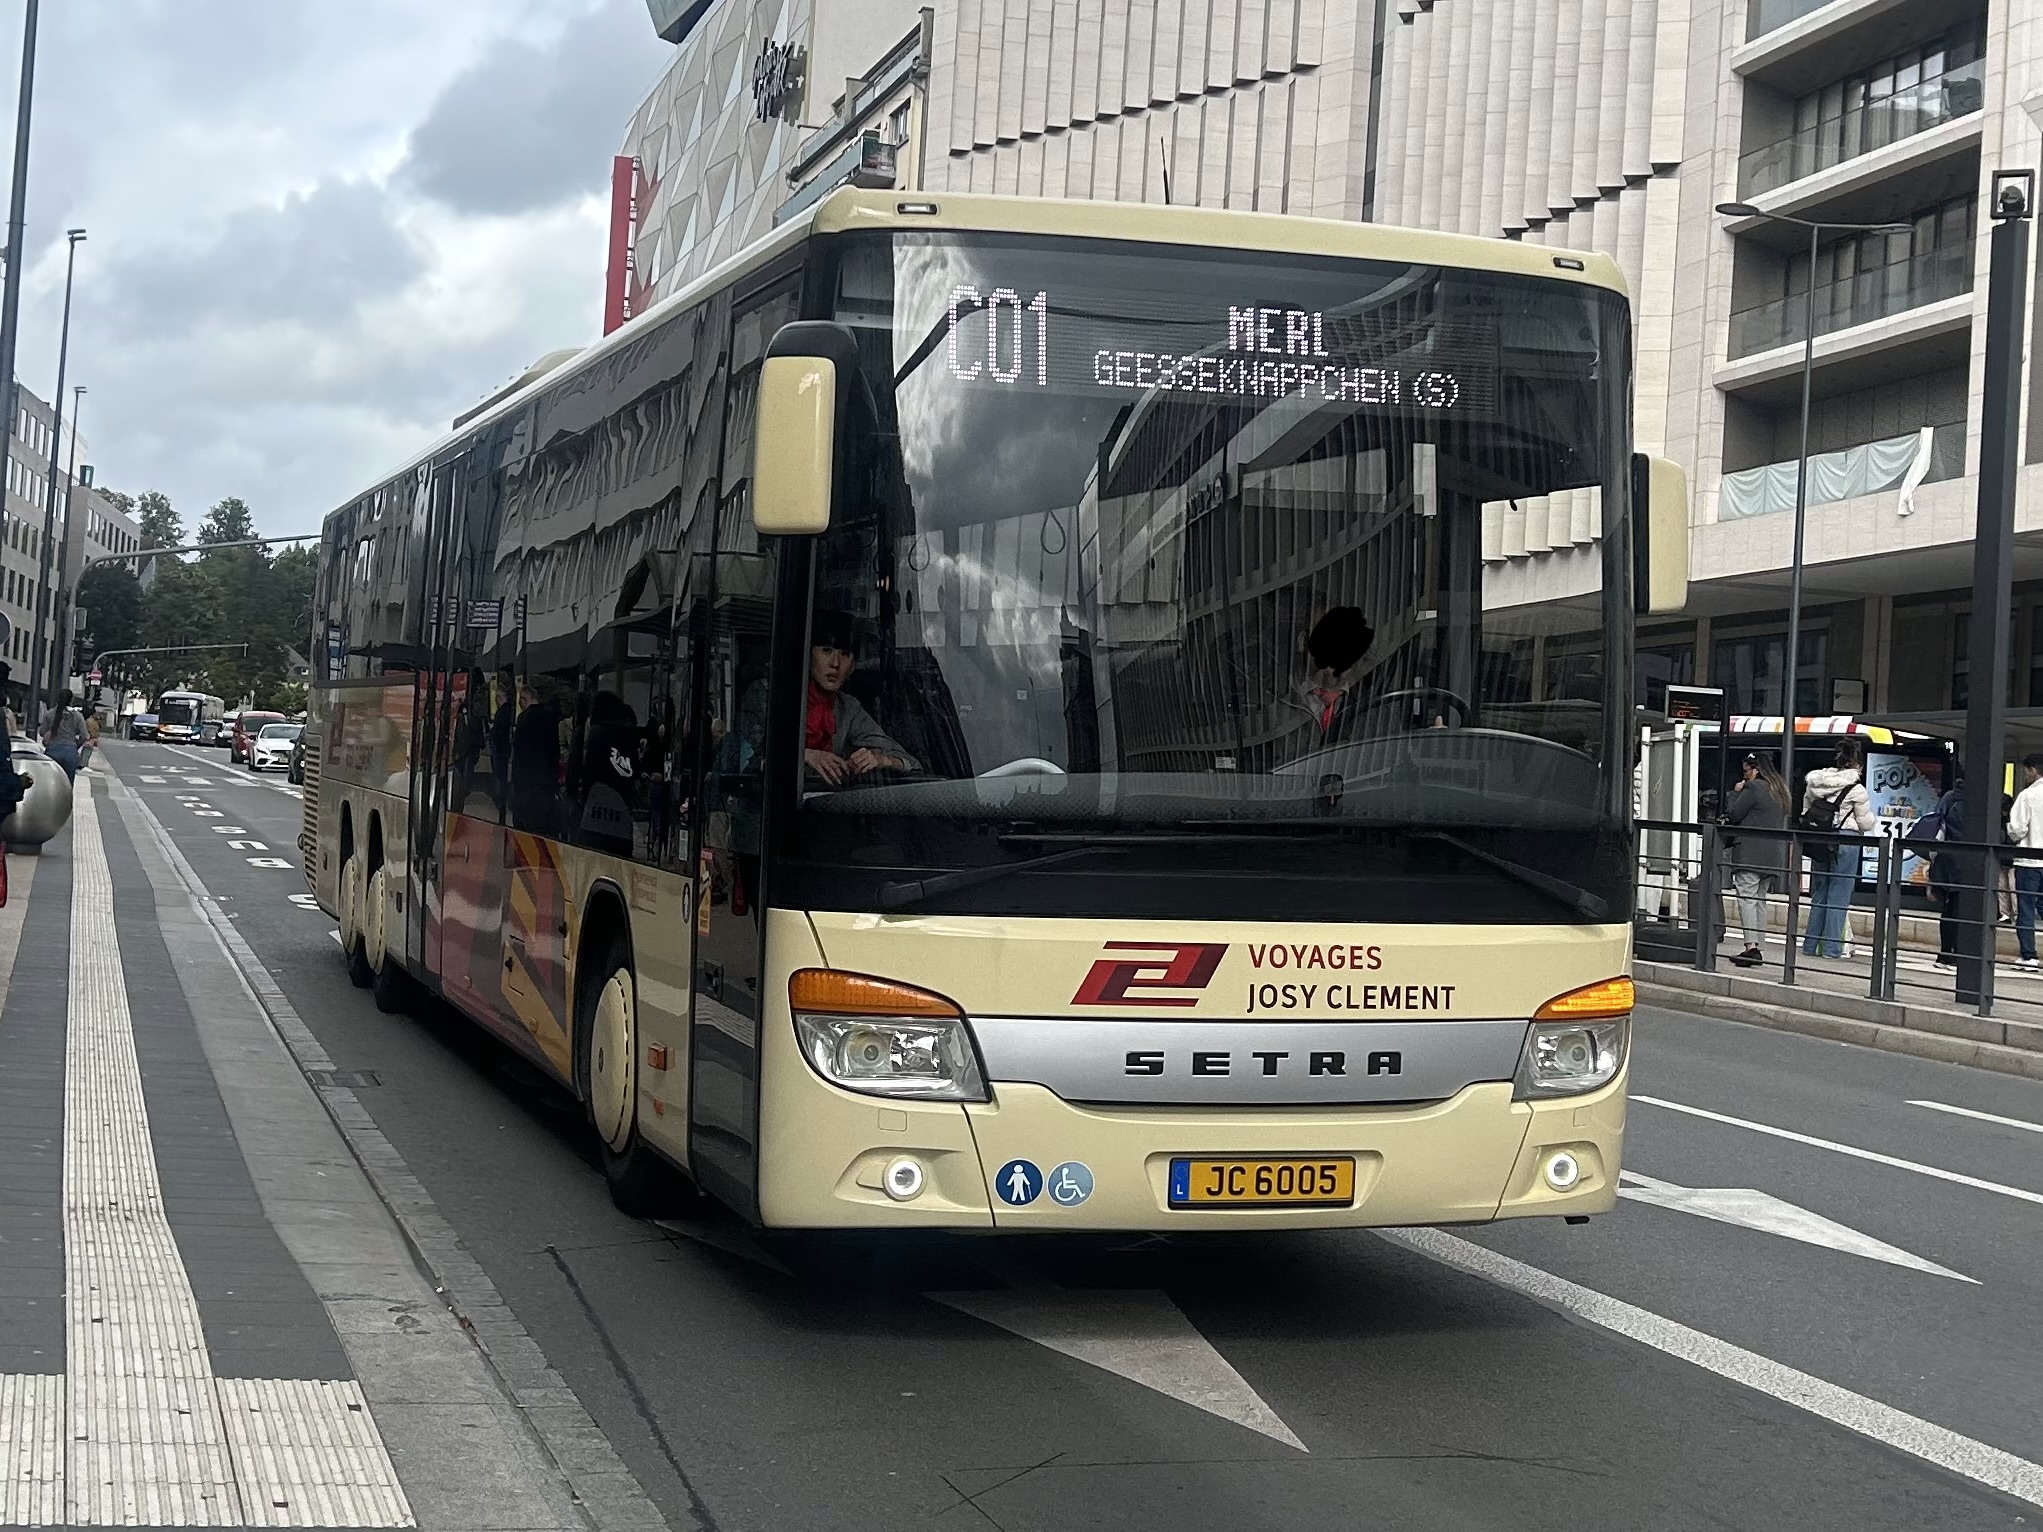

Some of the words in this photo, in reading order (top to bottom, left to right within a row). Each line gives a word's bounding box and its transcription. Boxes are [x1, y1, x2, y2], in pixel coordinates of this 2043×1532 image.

[948, 285, 1047, 385] C01
[1228, 305, 1329, 357] MERL
[1093, 349, 1400, 404] GEESSEKNAPPCHEN
[1413, 371, 1460, 408] (S)
[1873, 763, 1917, 793] POP
[1880, 820, 1915, 839] 31
[1247, 943, 1382, 970] VOYAGES
[1246, 983, 1317, 1014] JOSY
[1326, 984, 1456, 1010] CLEMENT
[1124, 1051, 1402, 1076] SETRA
[1176, 1184, 1184, 1195] L
[1205, 1165, 1246, 1196] JC
[1255, 1164, 1337, 1196] 6005
